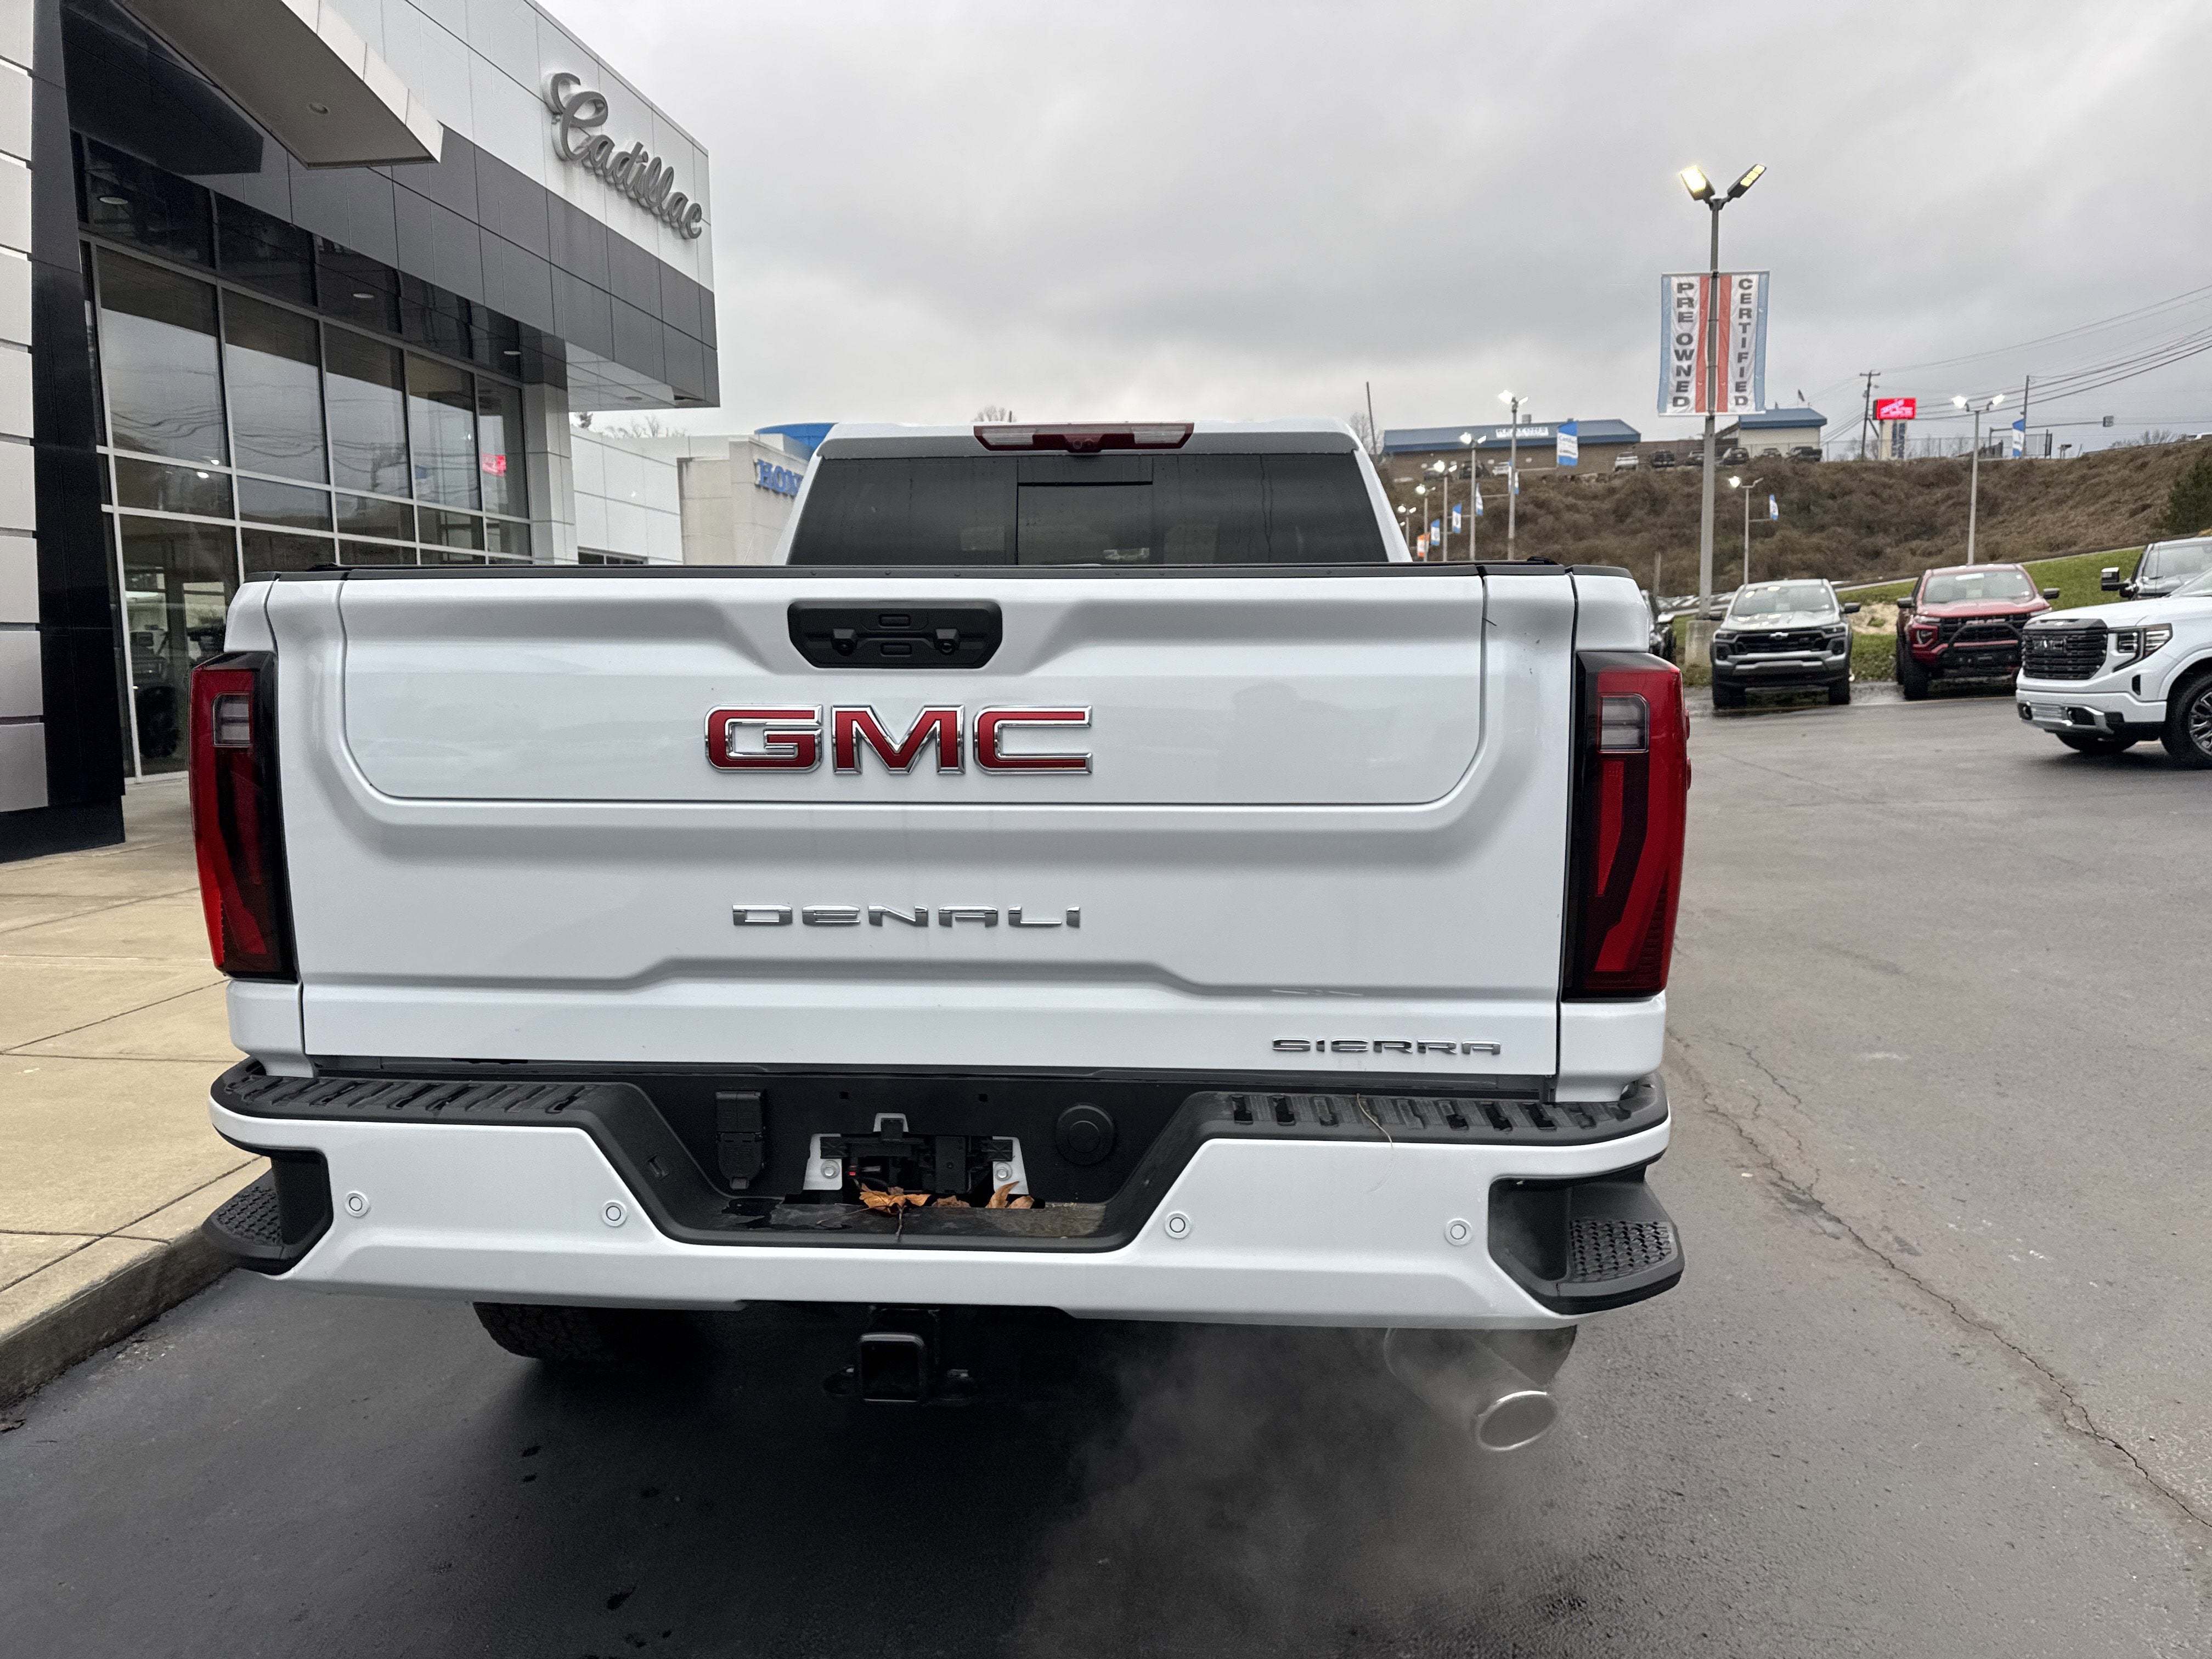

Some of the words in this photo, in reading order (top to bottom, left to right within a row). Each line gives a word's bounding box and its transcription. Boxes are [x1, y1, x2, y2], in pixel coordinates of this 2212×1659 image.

[549, 72, 702, 239] Cadillac
[1677, 283, 1695, 323] PRE
[1672, 332, 1695, 407] OWNED
[1735, 278, 1753, 406] CERTIFIED
[704, 704, 1093, 775] GMC
[732, 904, 1081, 928] DENALI
[1272, 1037, 1501, 1055] SIERRA
